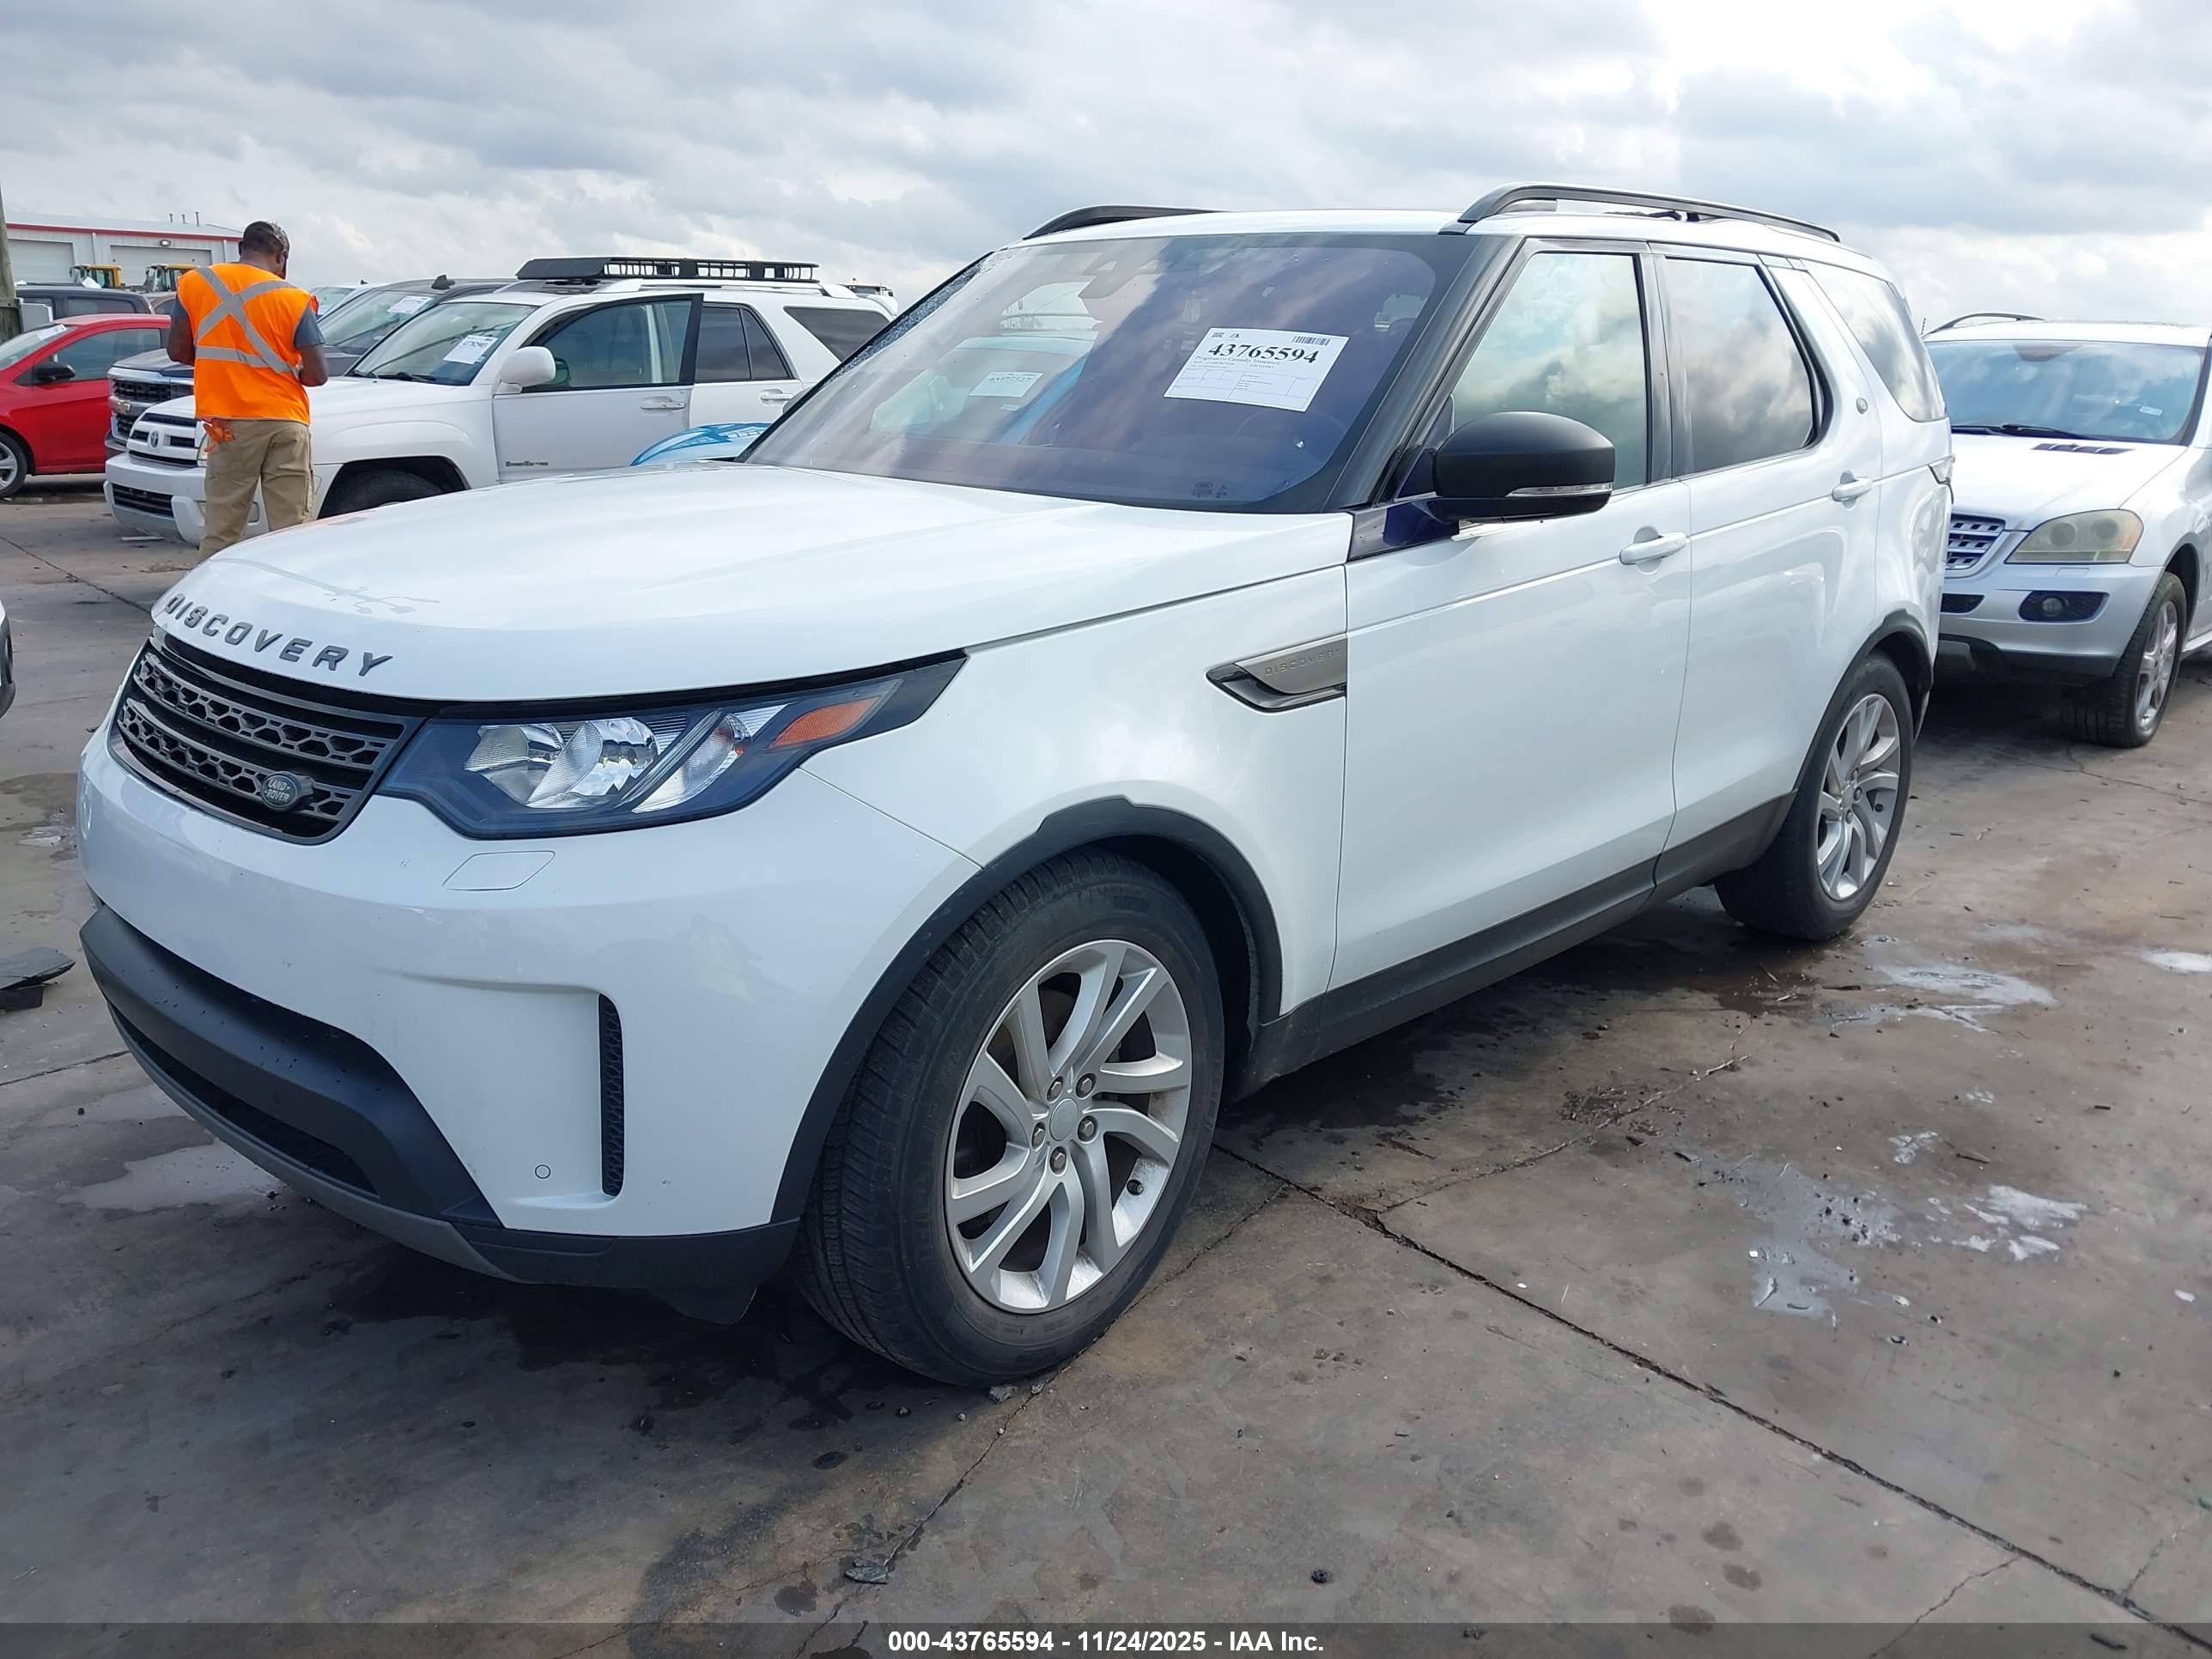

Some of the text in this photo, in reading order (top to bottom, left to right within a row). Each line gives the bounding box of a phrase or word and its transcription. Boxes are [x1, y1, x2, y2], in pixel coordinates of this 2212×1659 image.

[1209, 343, 1320, 364] 43765594
[163, 592, 393, 677] DISCOVERY
[268, 779, 288, 791] LAND
[266, 788, 290, 802] ROVER
